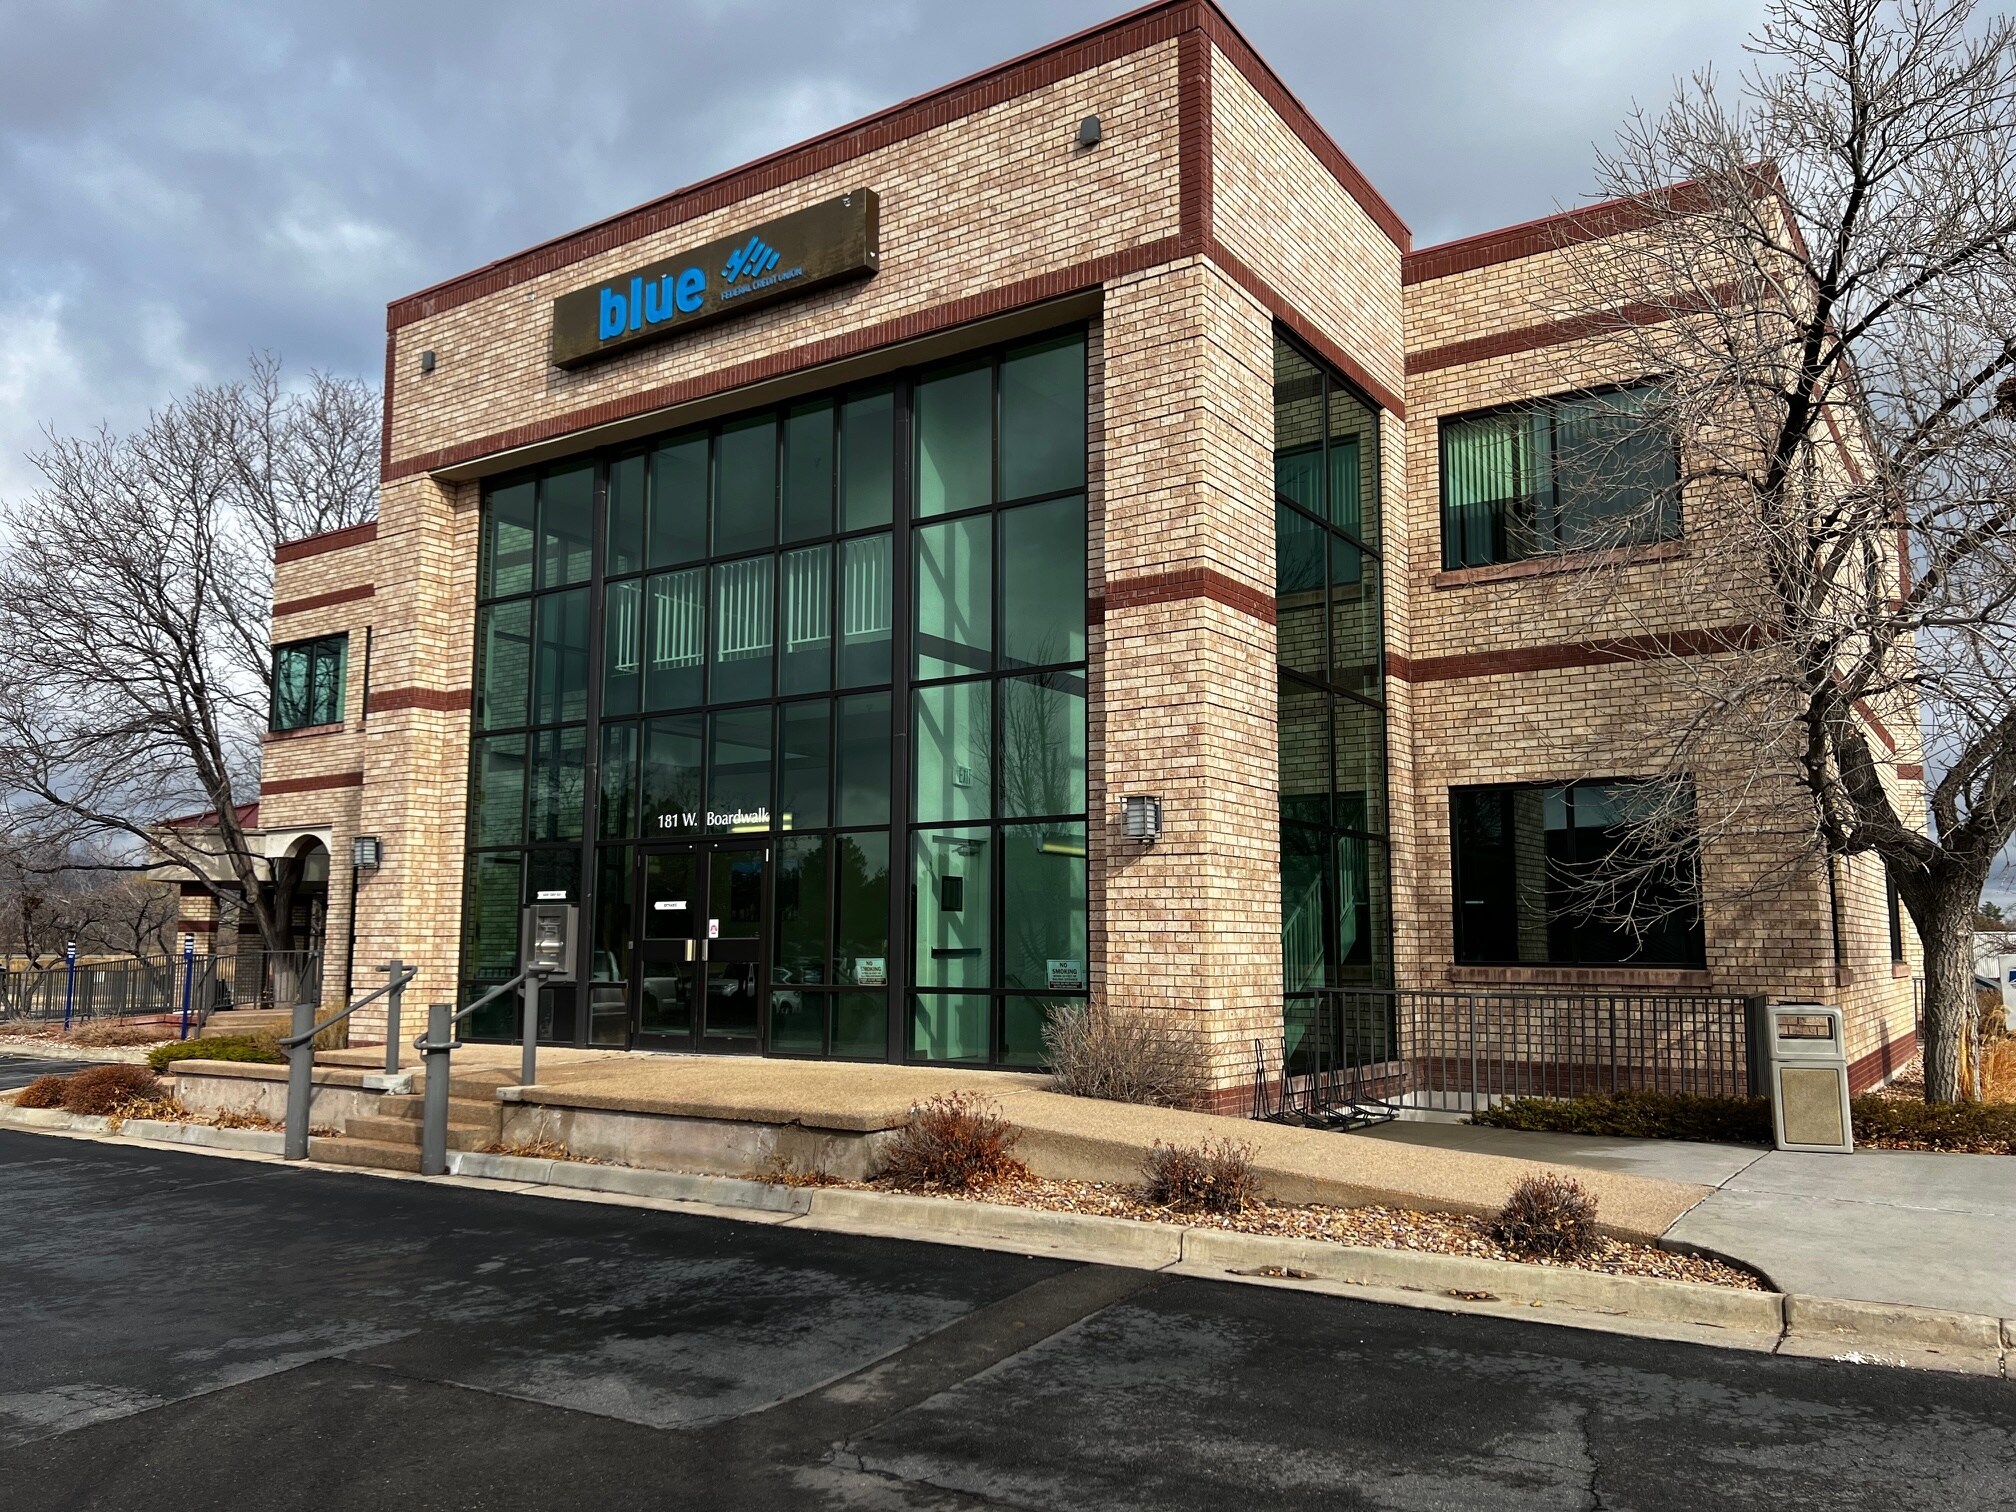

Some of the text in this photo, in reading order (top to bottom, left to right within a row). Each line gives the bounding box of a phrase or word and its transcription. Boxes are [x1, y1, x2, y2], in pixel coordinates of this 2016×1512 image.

[721, 267, 803, 300] FEDERAL CREDIT UNION
[599, 265, 706, 341] blue
[658, 807, 770, 829] 181 W. Boardwalk
